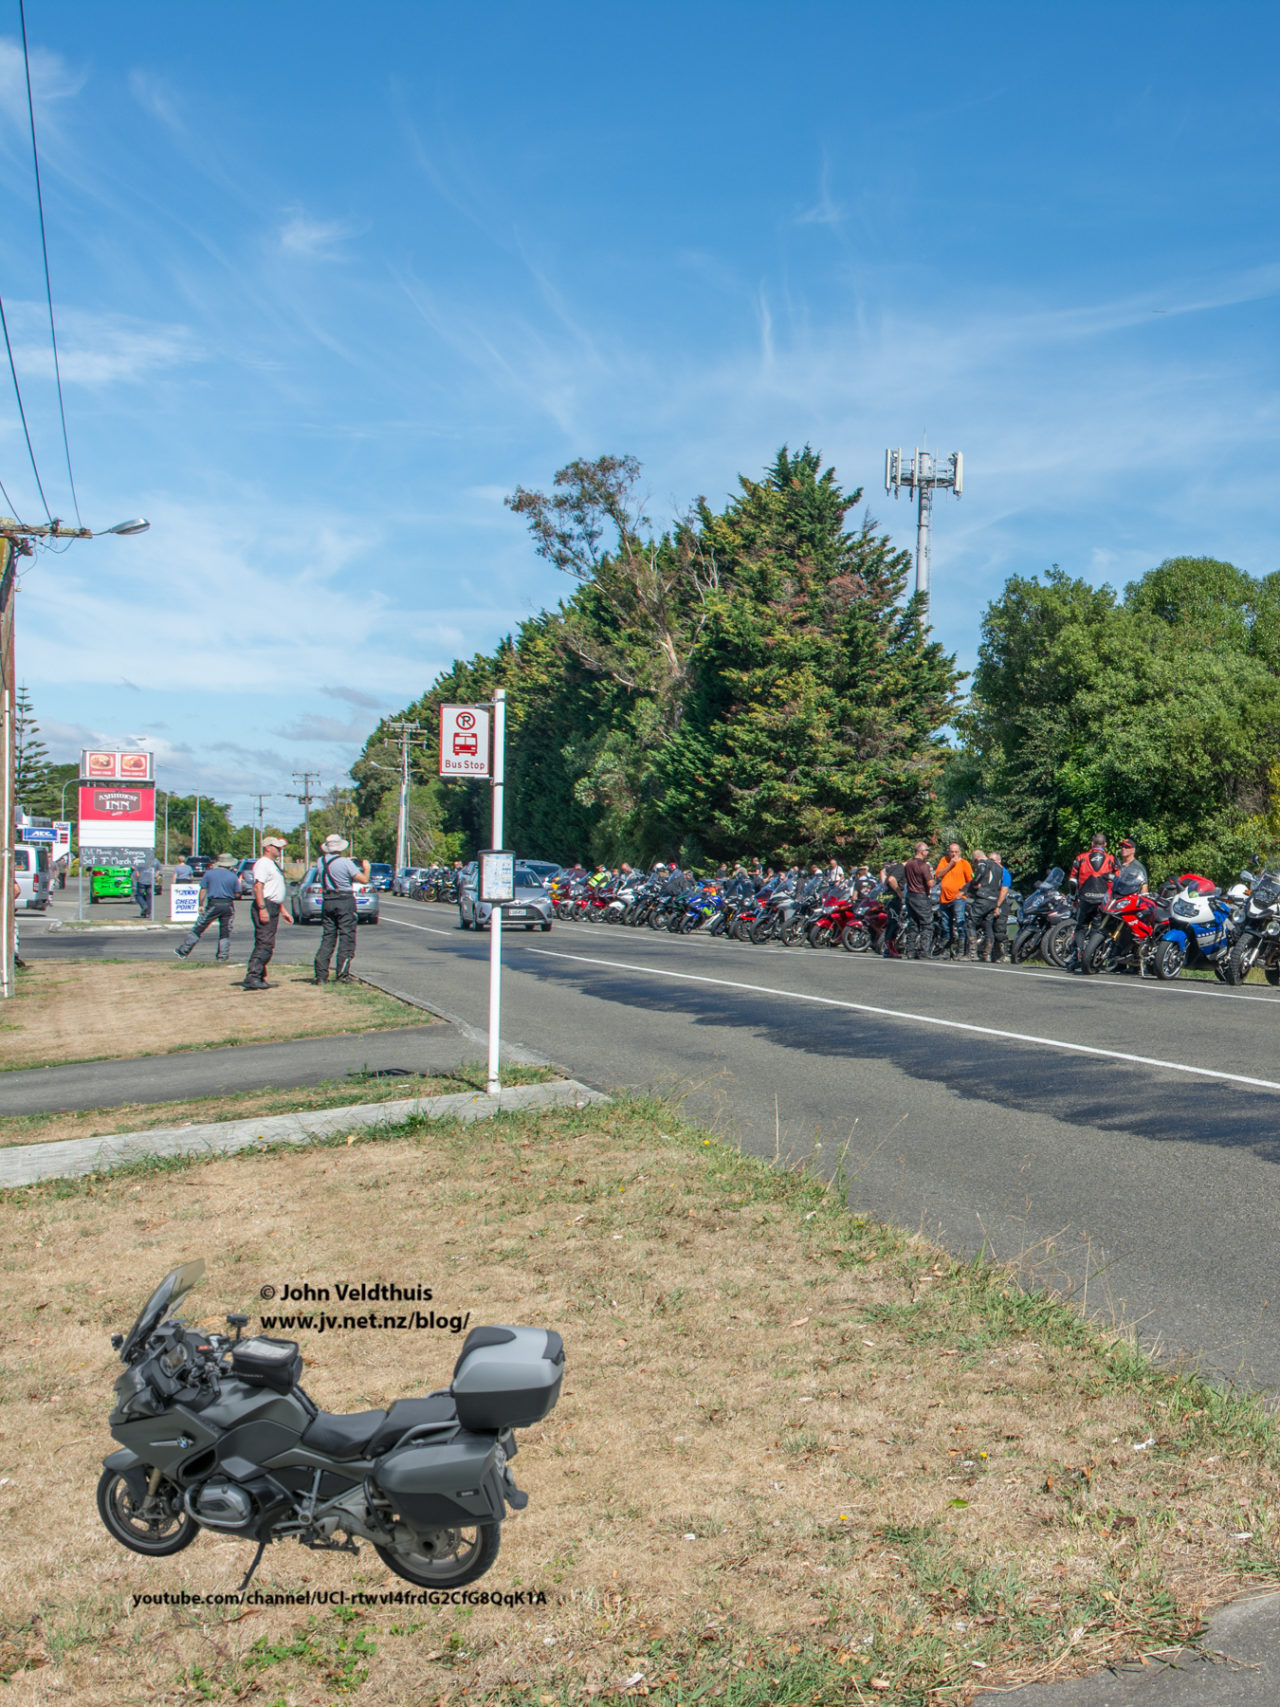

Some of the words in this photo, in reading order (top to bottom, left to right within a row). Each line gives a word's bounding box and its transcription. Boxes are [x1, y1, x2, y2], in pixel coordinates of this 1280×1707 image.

[445, 760, 462, 769] Bus
[464, 760, 485, 770] Stop
[105, 800, 131, 811] INN
